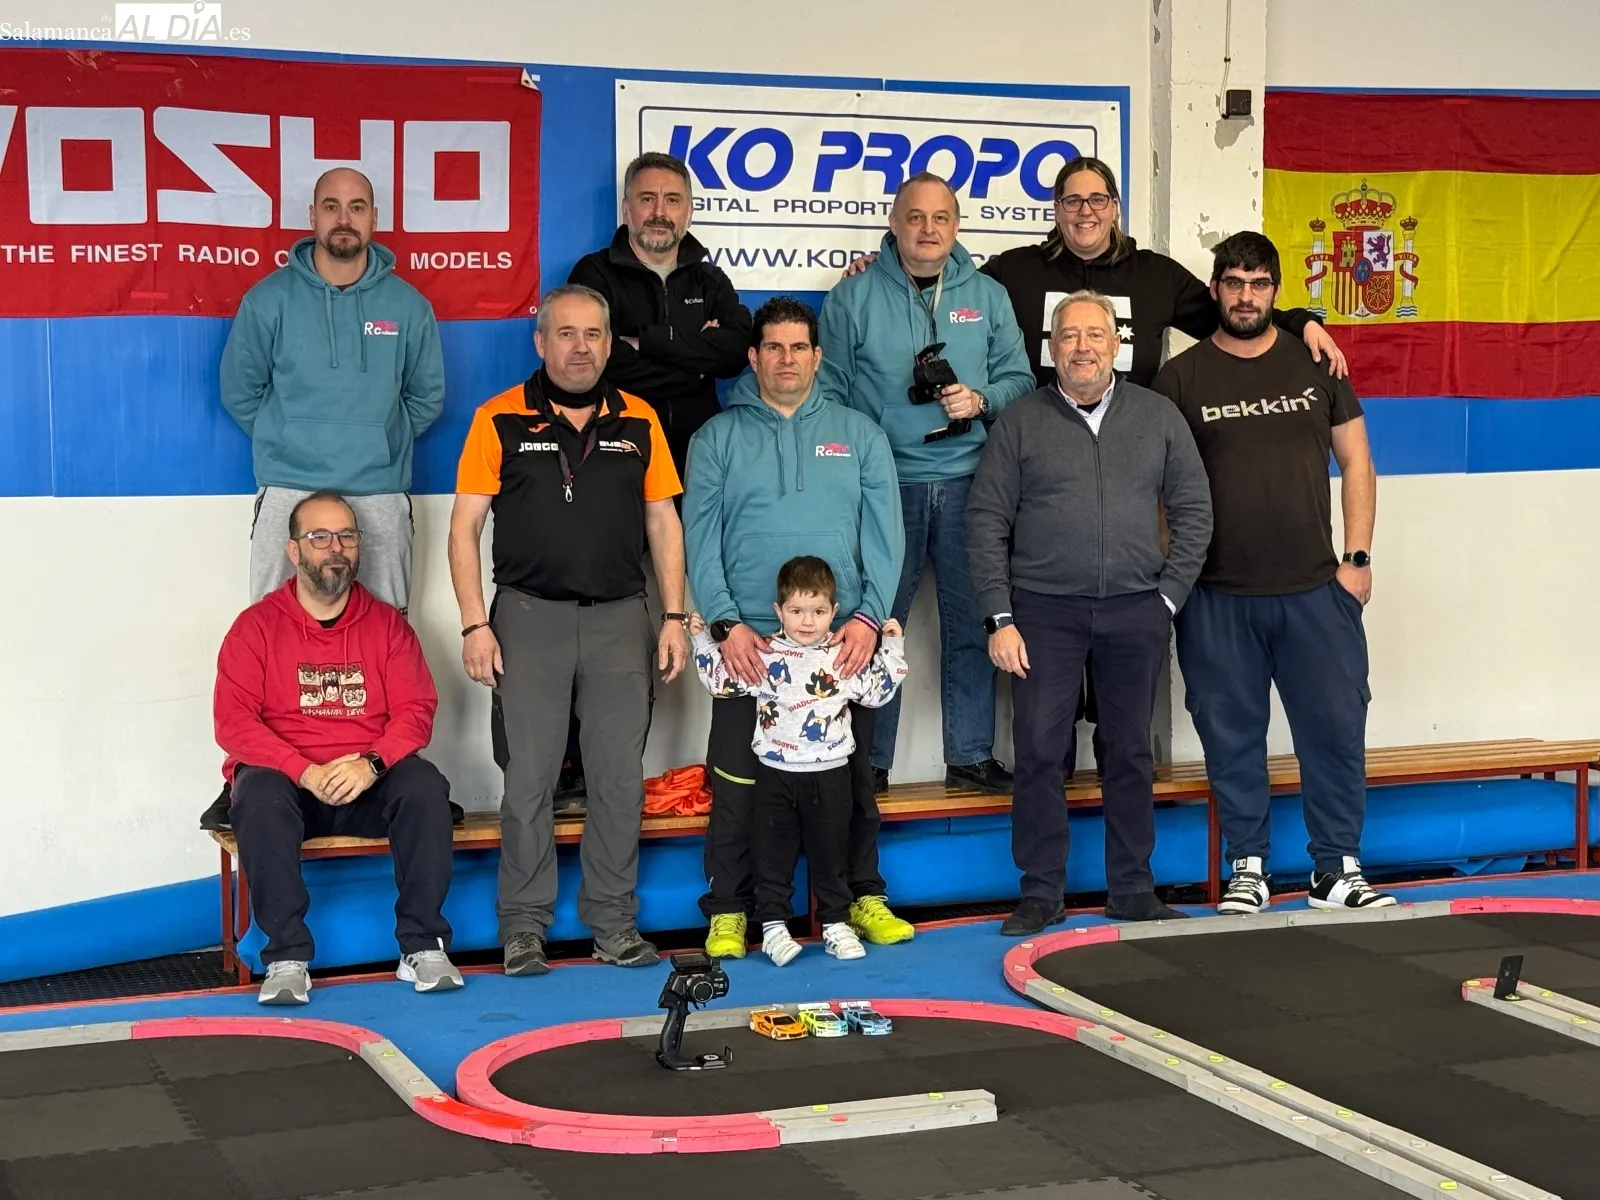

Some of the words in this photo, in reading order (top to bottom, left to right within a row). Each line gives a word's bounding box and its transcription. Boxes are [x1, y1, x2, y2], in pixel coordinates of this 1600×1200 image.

[0, 104, 511, 233] OSHO
[668, 125, 794, 192] KO
[812, 131, 1082, 202] PROPO
[693, 197, 760, 213] GITAL
[774, 199, 969, 217] PROPORT
[981, 206, 1055, 222] SYSTE
[0, 244, 55, 264] THE
[71, 243, 164, 264] FINEST
[178, 244, 260, 267] RADIO
[410, 252, 513, 270] MODELS
[1200, 395, 1311, 423] bekkin
